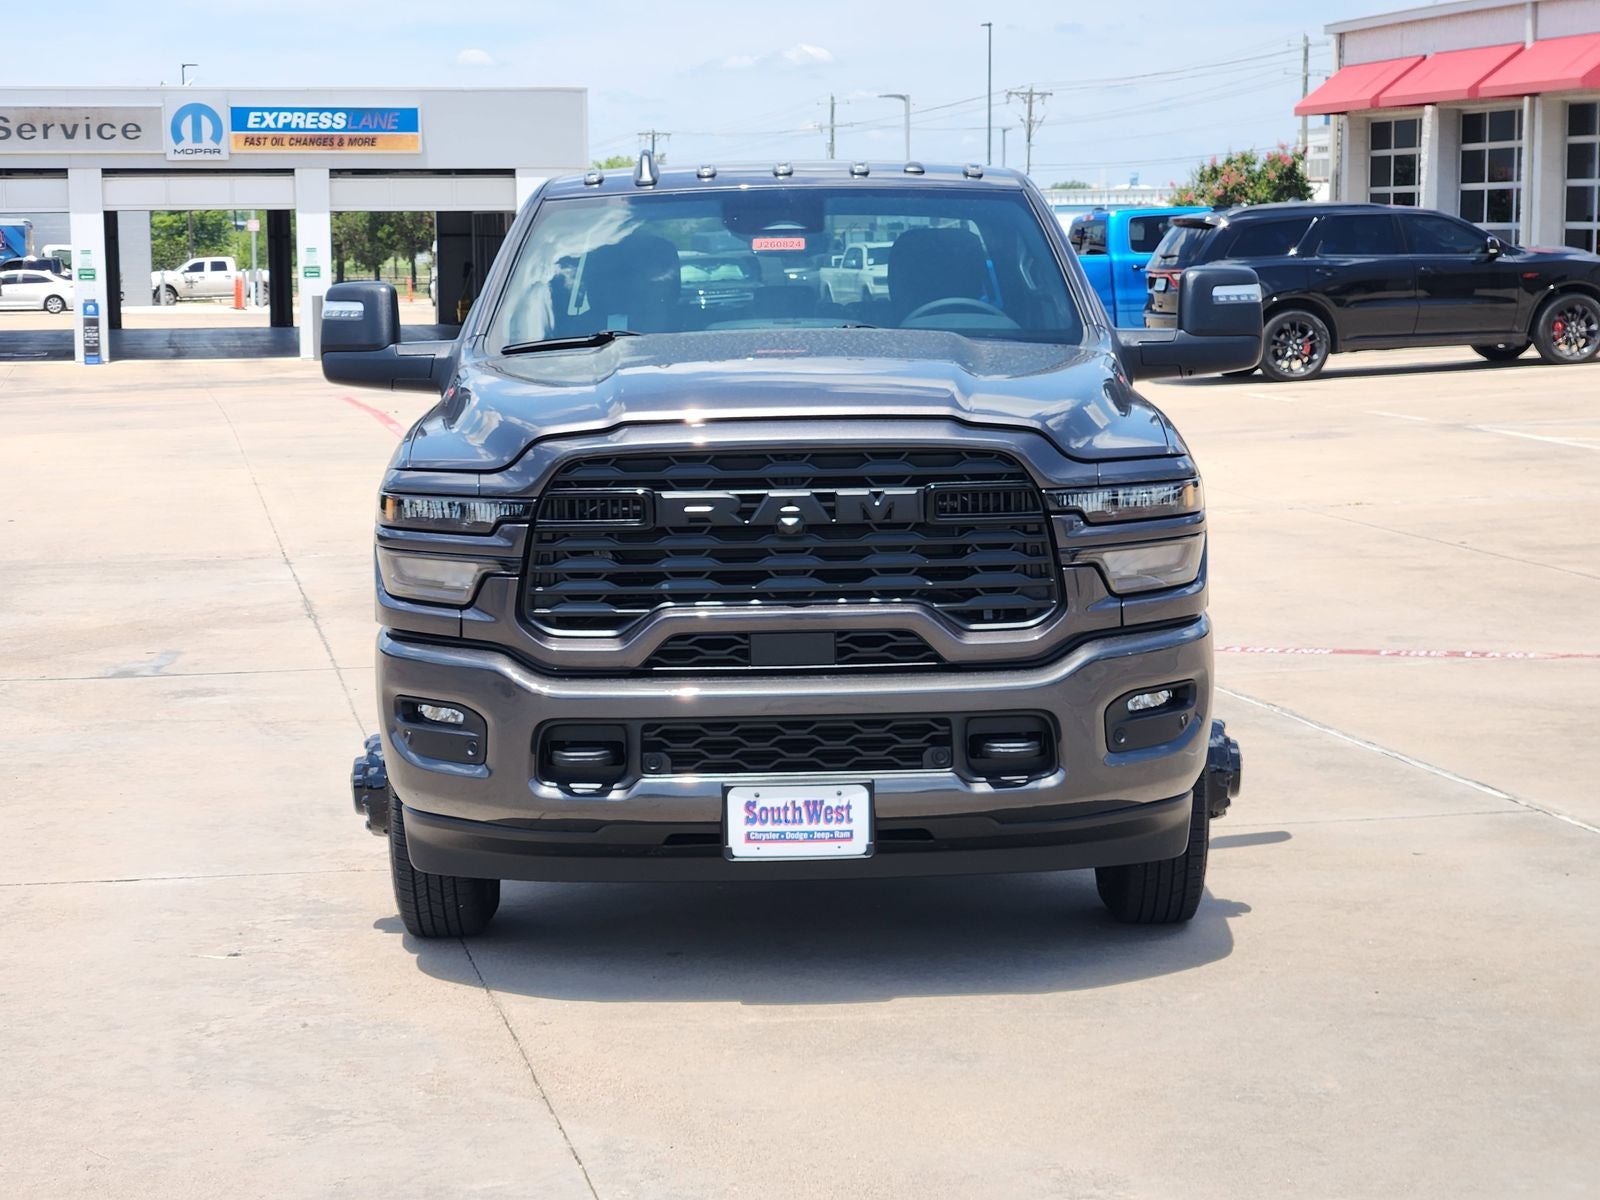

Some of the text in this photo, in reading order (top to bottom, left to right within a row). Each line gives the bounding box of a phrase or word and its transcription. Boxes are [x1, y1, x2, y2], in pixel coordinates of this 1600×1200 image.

[0, 115, 142, 140] Service
[243, 137, 377, 147] FAST OIL CHANGES & MORE
[661, 490, 918, 526] RAM
[744, 799, 853, 826] SouthWest
[750, 831, 850, 841] Chrysler Dodge Jeep Ram
